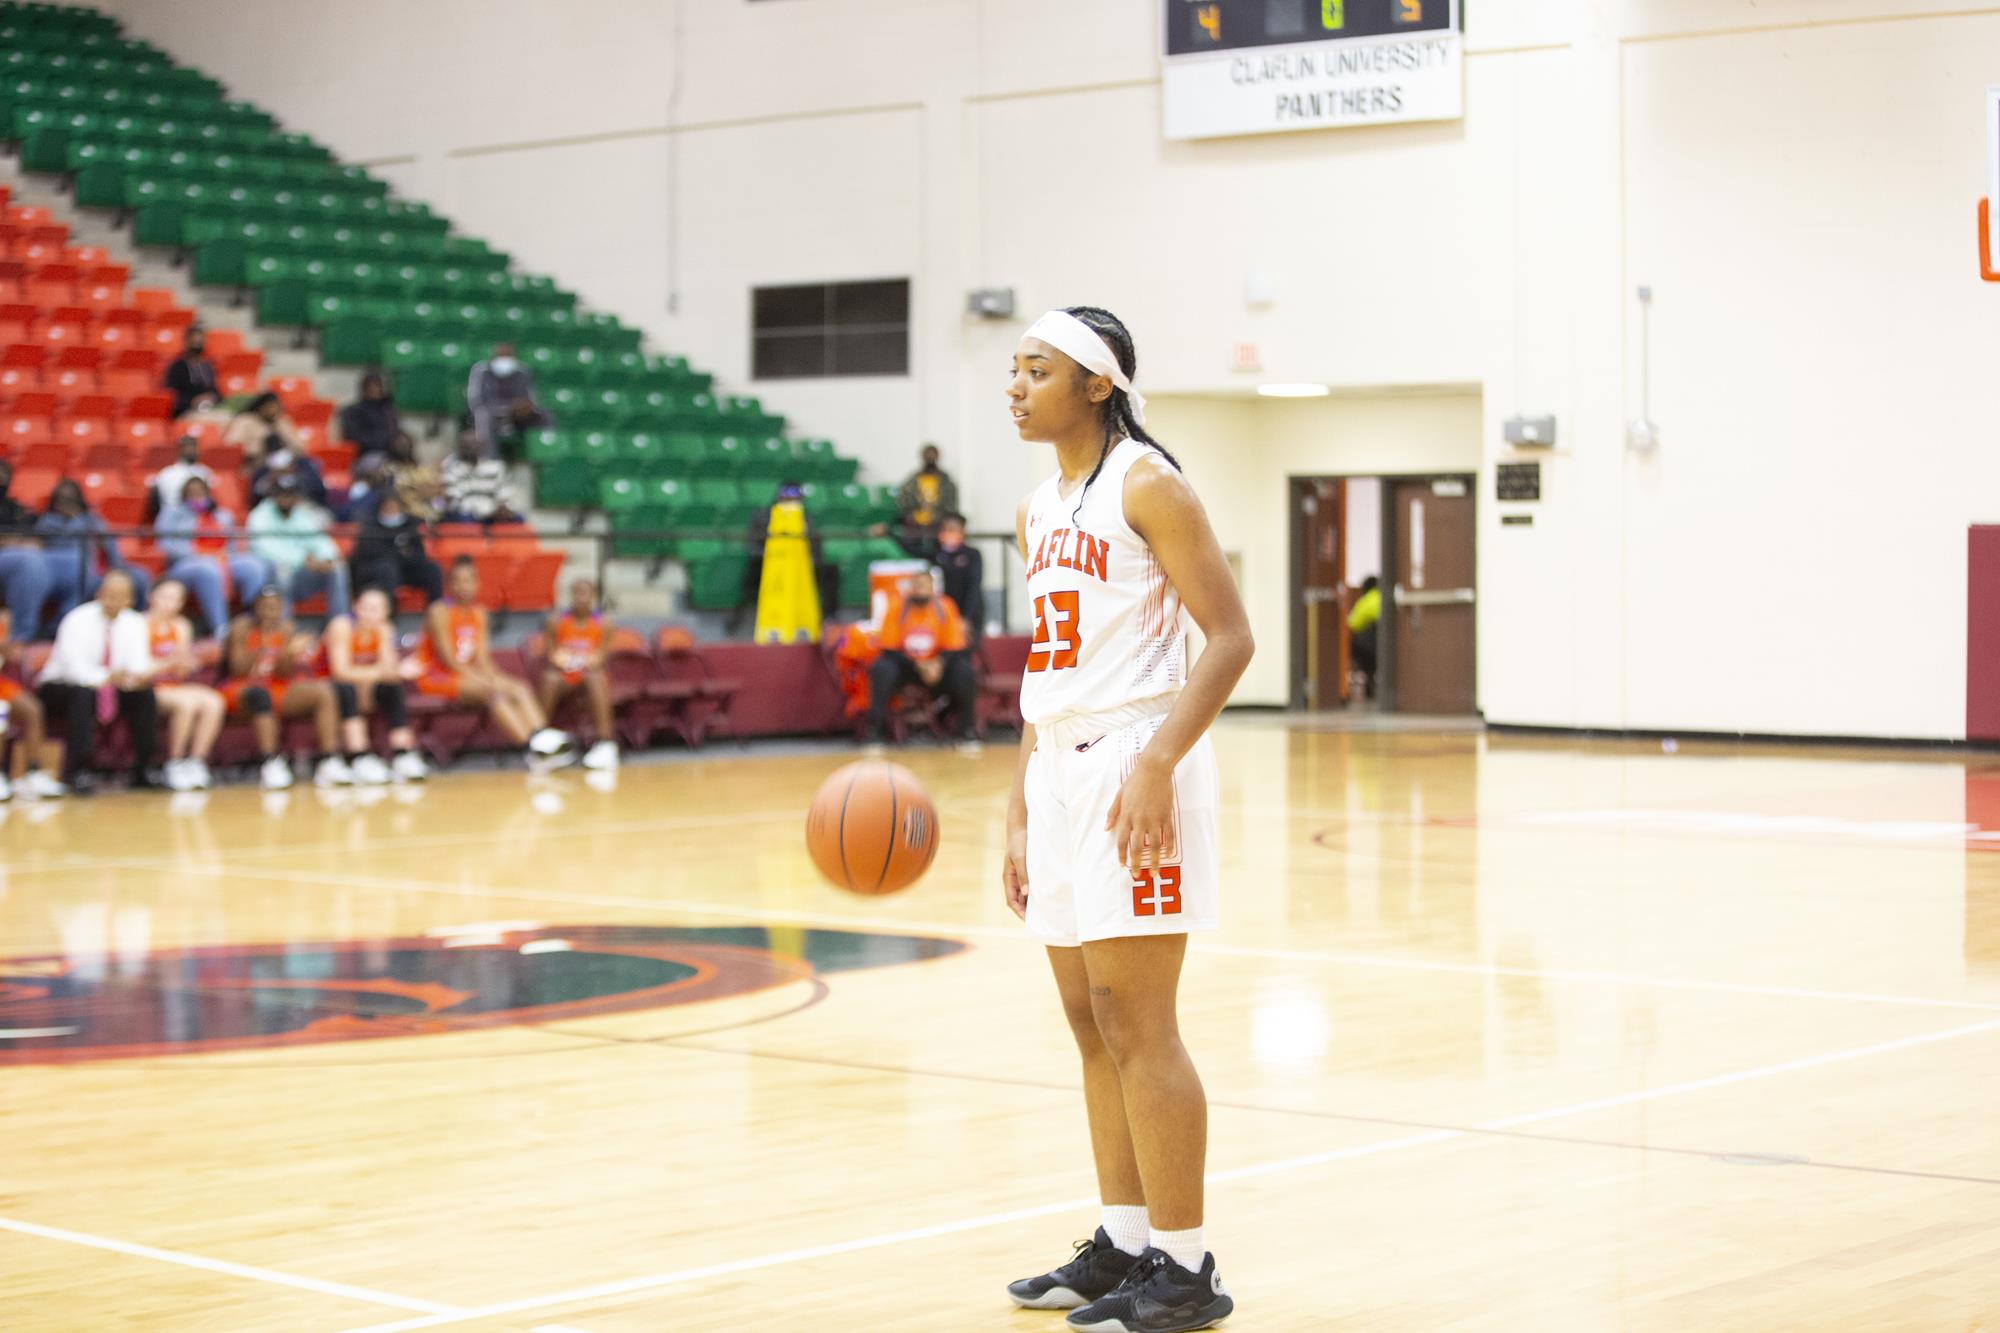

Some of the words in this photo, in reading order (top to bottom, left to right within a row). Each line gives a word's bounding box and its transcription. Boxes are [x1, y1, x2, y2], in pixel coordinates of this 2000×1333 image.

[1197, 4, 1221, 42] 4
[1231, 53, 1316, 85] CLAFLIN
[1325, 41, 1448, 77] UNIVERSITY
[1276, 86, 1403, 120] PANTHERS
[1027, 590, 1082, 672] 23
[1129, 865, 1182, 917] 23
